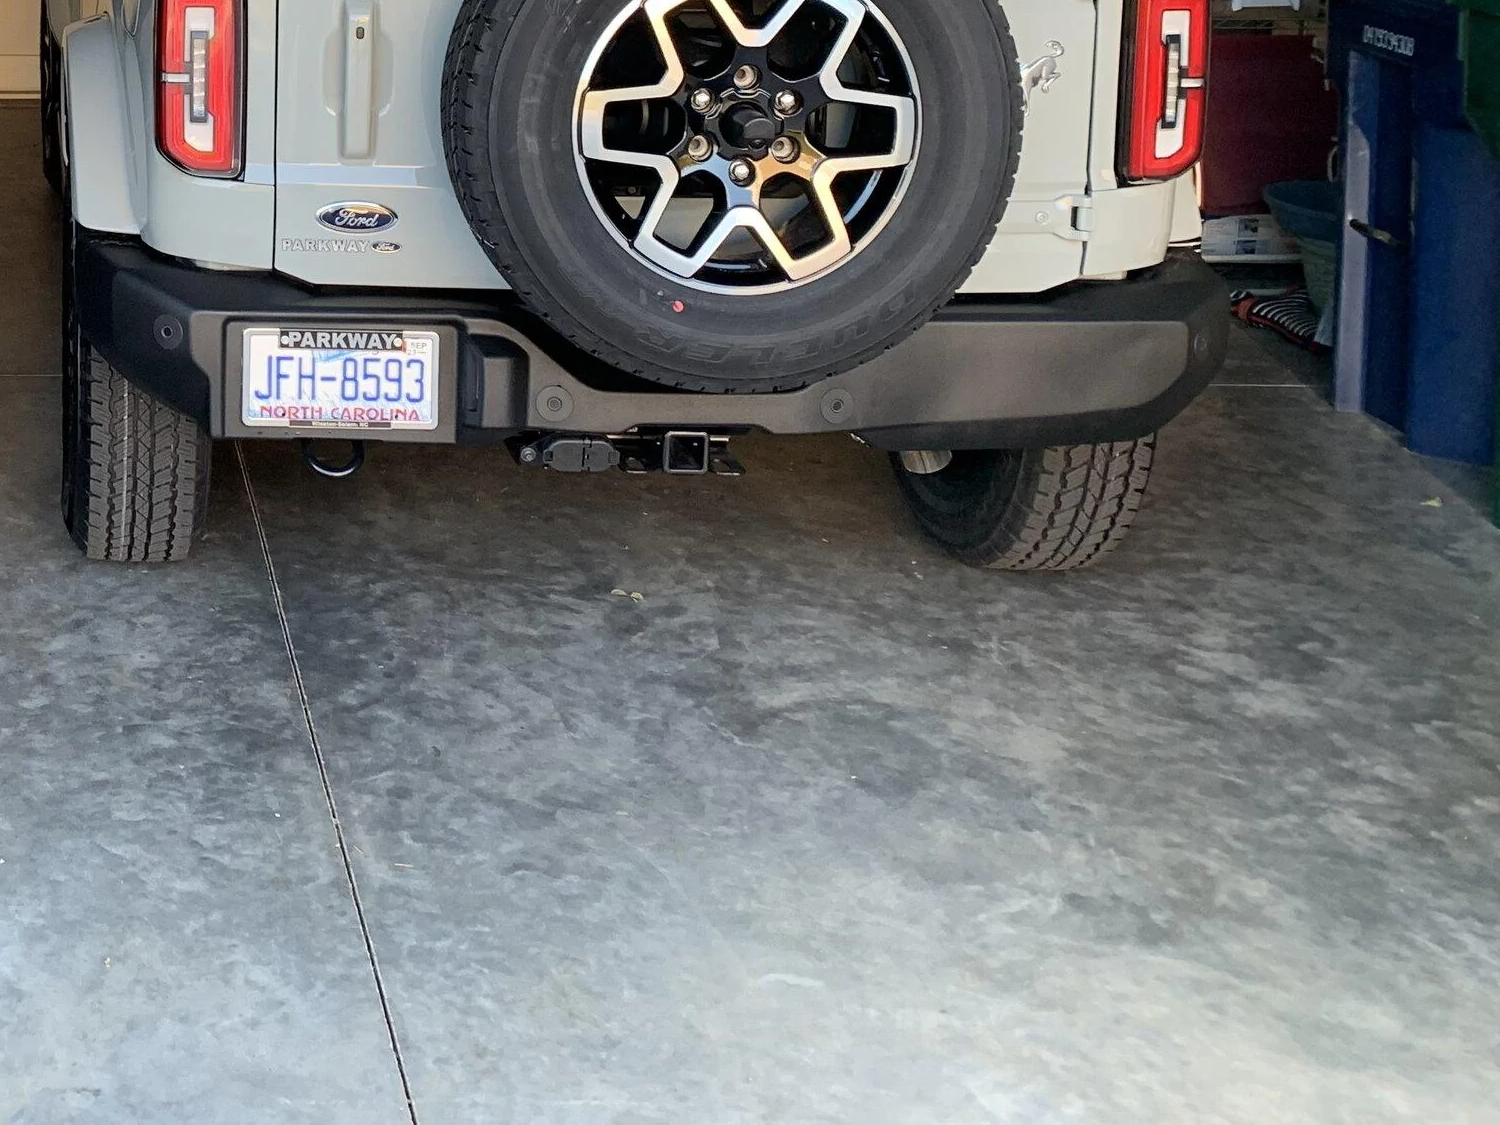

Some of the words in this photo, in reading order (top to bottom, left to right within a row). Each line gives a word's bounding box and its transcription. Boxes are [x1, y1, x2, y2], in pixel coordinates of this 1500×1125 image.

[334, 208, 380, 227] Ford
[281, 238, 370, 253] PARKWAY
[288, 331, 397, 350] PARKWAY
[254, 355, 425, 403] JFH-8593
[260, 405, 323, 419] NORTH
[331, 407, 420, 421] CAROLINA
